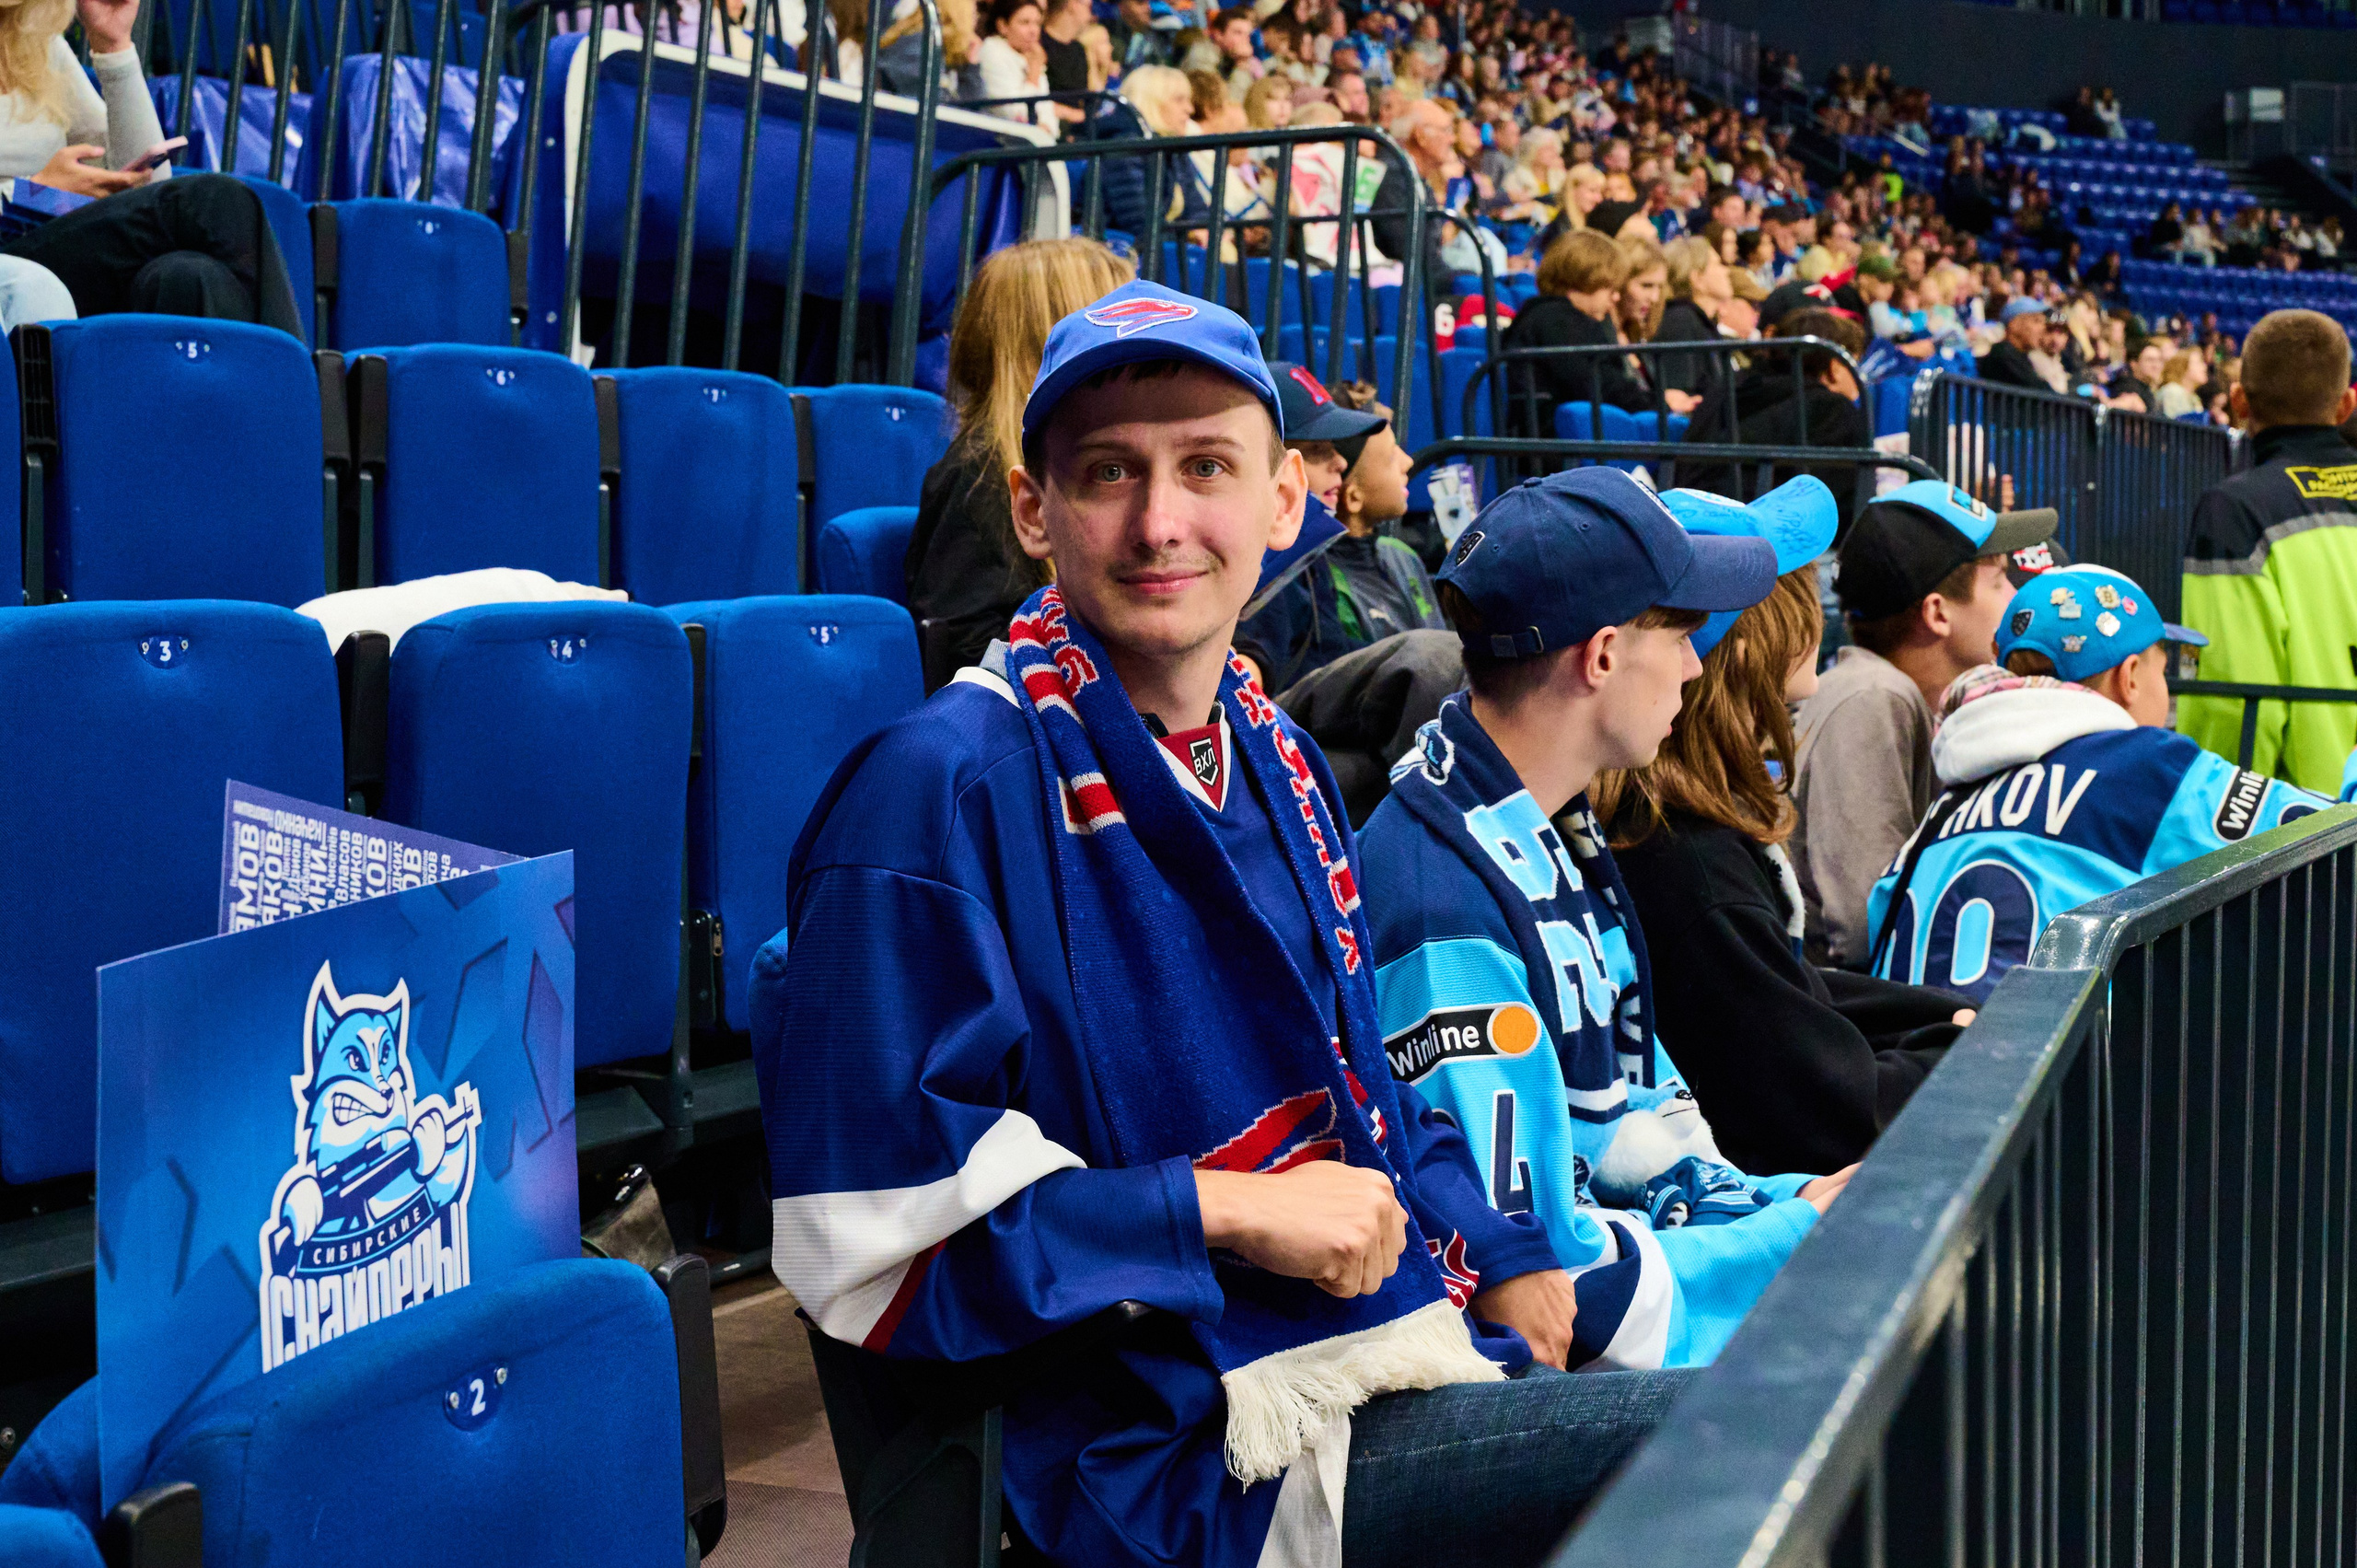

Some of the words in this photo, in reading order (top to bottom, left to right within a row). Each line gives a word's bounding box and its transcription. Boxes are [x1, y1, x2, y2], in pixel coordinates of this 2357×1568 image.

[188, 342, 197, 359] 5
[496, 370, 506, 386] 6
[712, 389, 719, 403] 7
[820, 626, 830, 644] 5
[159, 641, 171, 662] 3
[562, 640, 573, 658] 4
[1193, 747, 1215, 776] ВХЛ
[334, 829, 351, 902] Власов
[1386, 1024, 1481, 1077] Winline
[313, 1206, 421, 1266] СИБИРСКИЕ
[470, 1377, 486, 1417] 2
